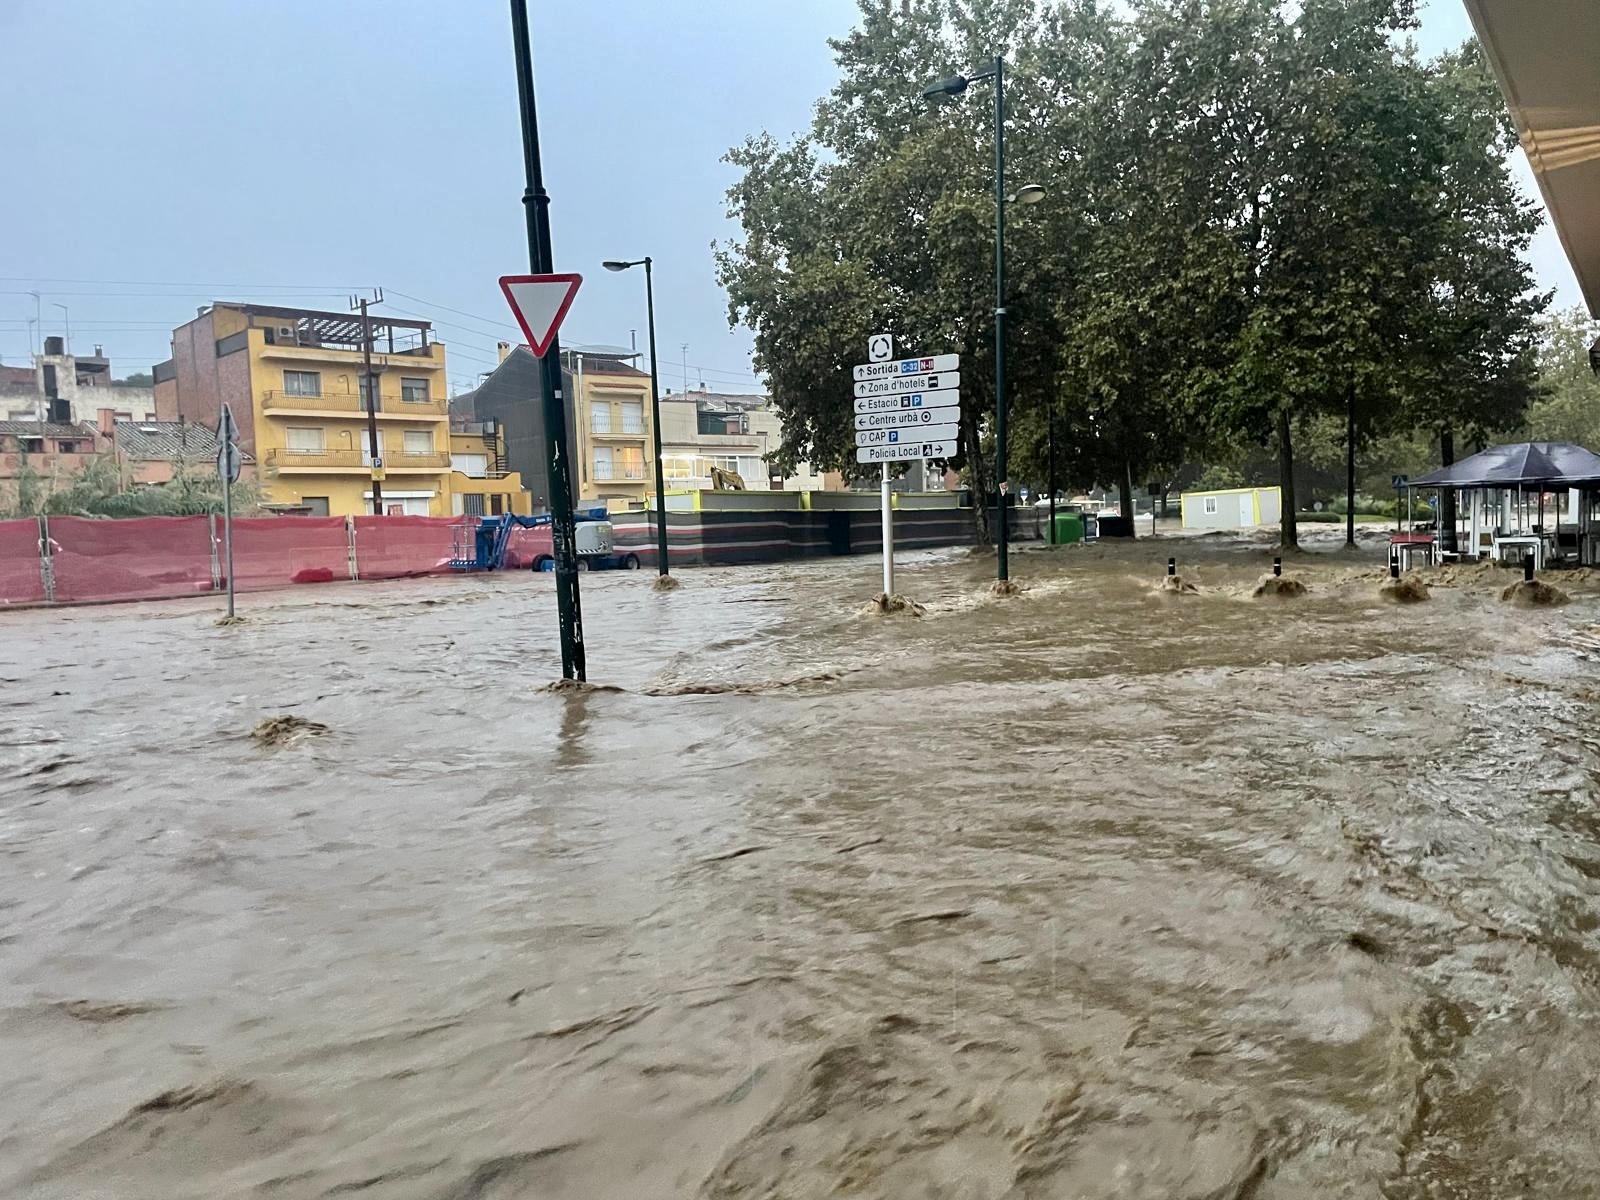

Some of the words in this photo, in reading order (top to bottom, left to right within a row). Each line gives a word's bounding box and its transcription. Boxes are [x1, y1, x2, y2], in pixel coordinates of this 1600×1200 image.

[867, 363, 899, 376] Sortida
[902, 362, 918, 372] C-32
[868, 383, 889, 393] Zona
[891, 378, 926, 390] d'hotels
[868, 398, 898, 409] Estació
[869, 414, 897, 426] Centre
[899, 410, 918, 422] urbà
[869, 432, 886, 442] CAP
[890, 433, 897, 441] P
[898, 445, 920, 457] Local
